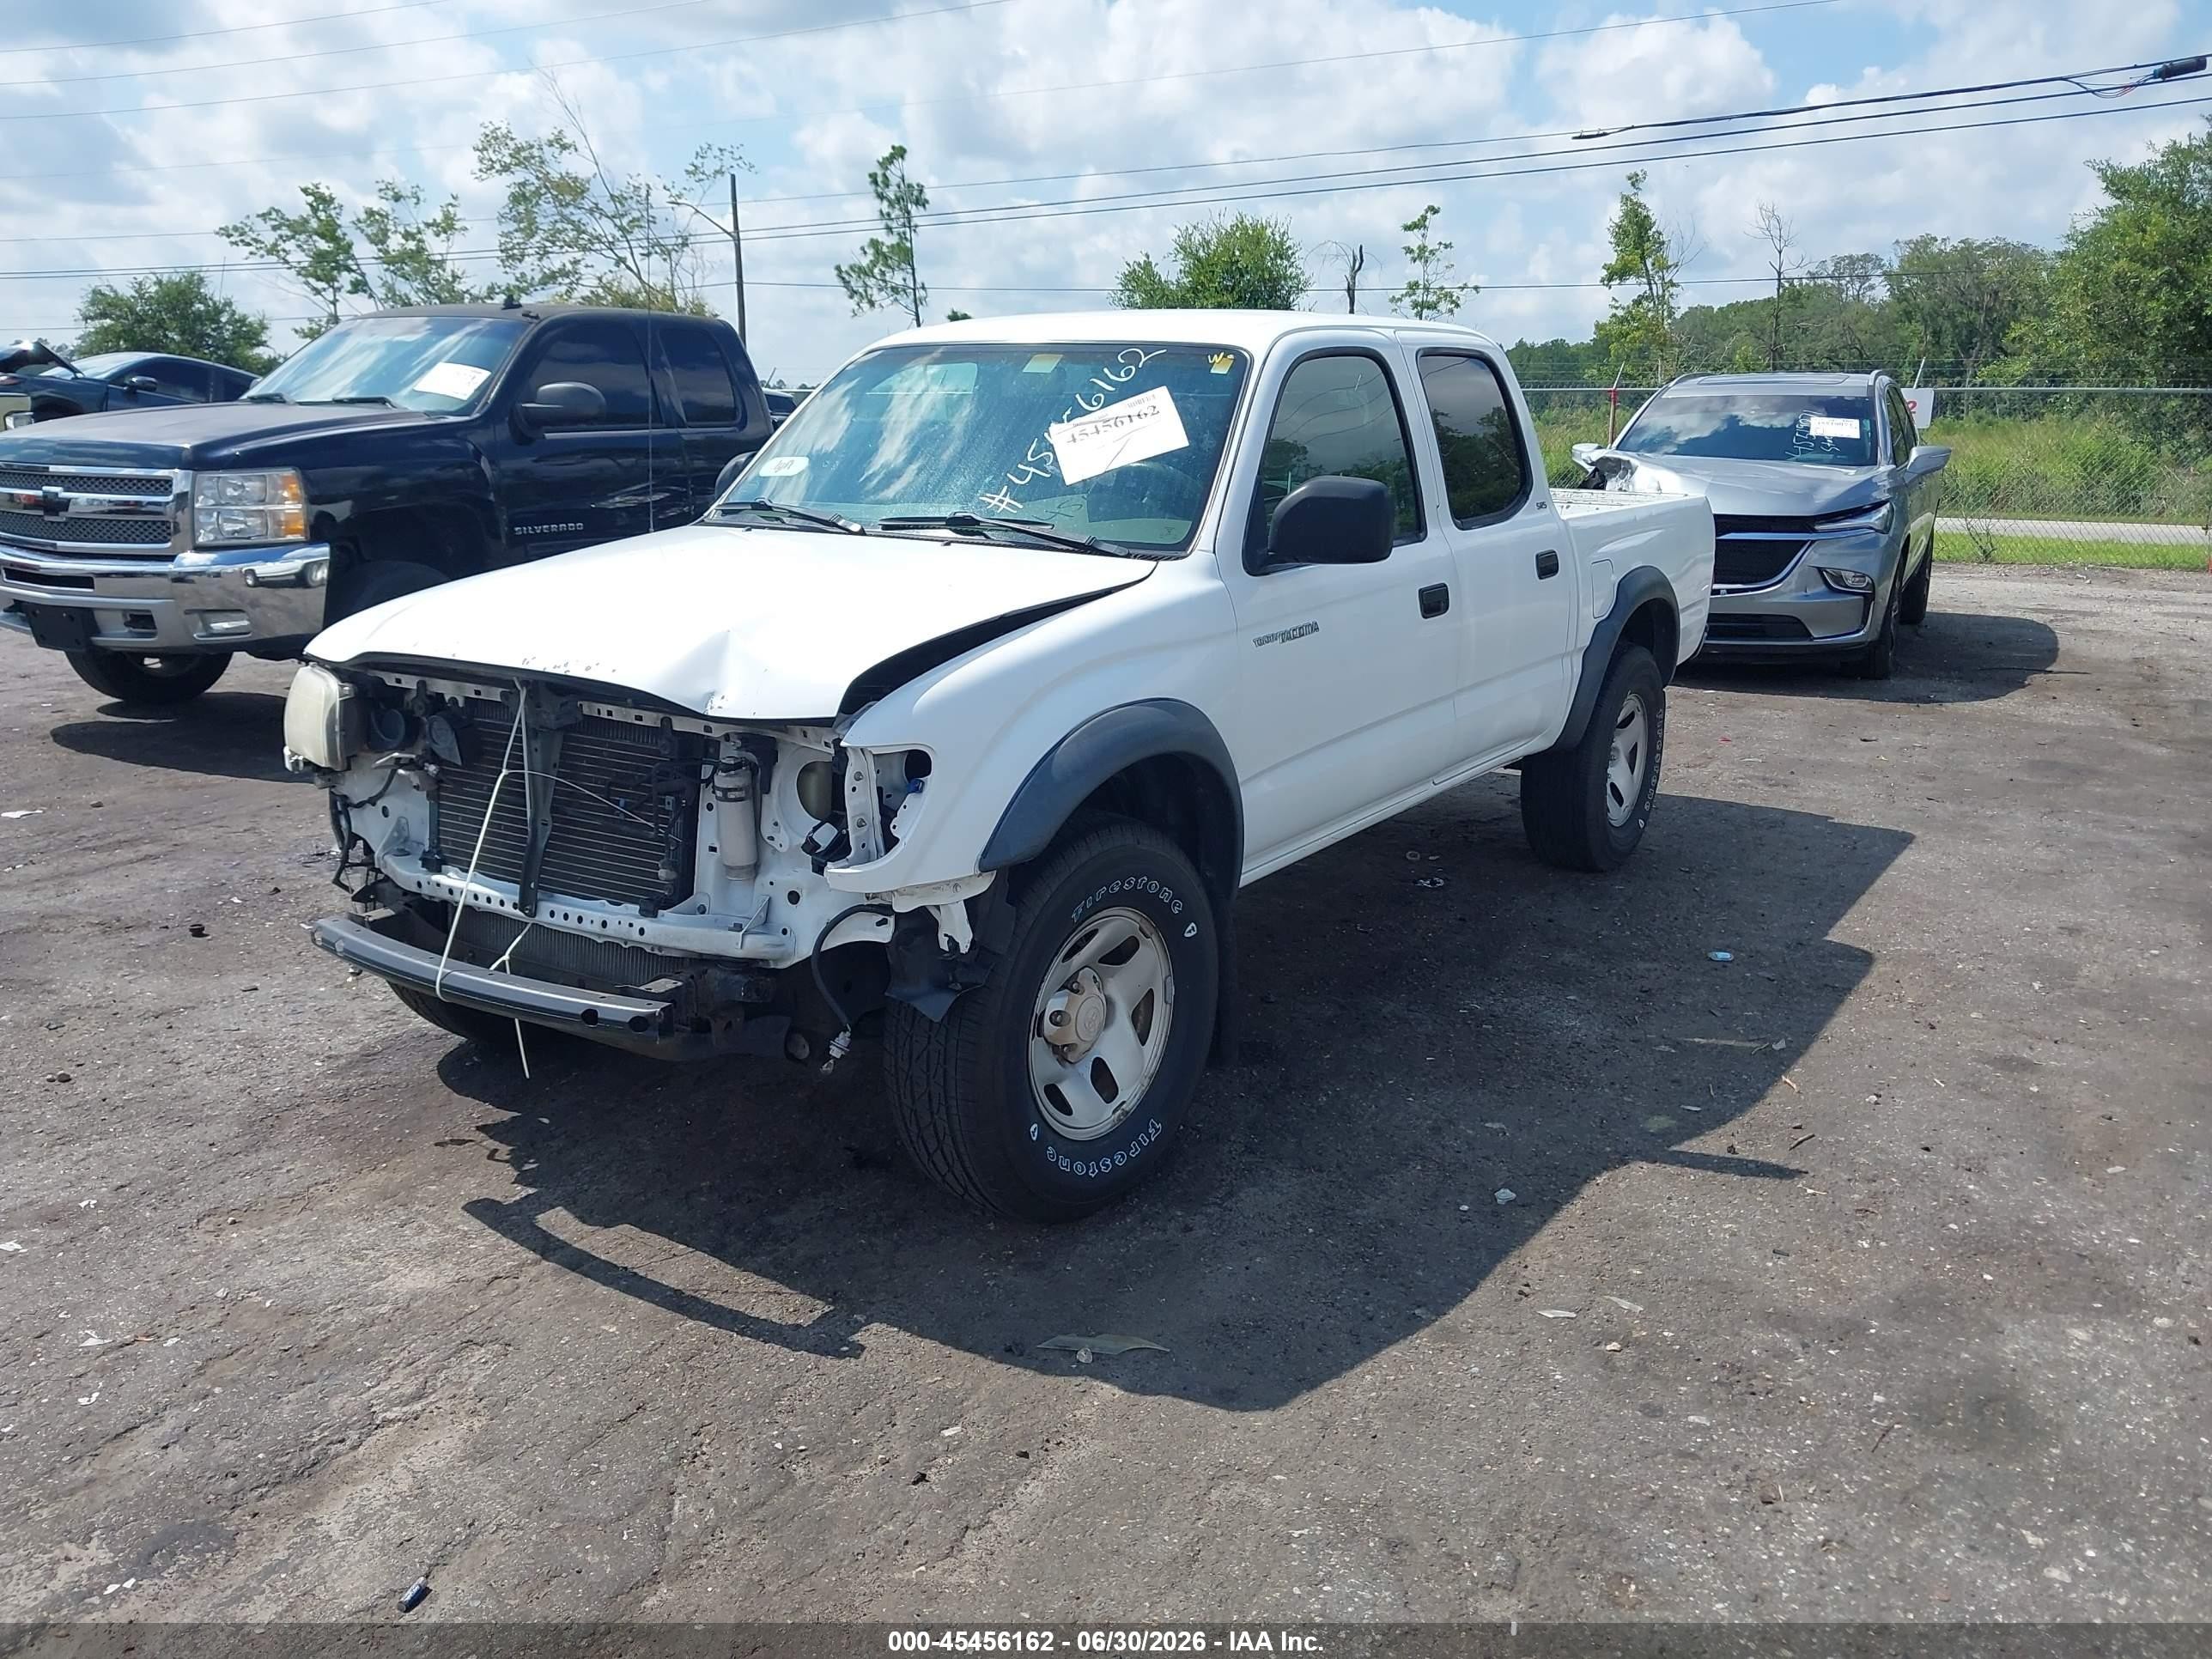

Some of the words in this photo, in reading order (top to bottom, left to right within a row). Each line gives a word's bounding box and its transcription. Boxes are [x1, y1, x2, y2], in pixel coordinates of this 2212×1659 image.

[514, 522, 584, 535] SILVERADO
[1071, 875, 1183, 924] Firestone
[1045, 1117, 1163, 1179] Firestone
